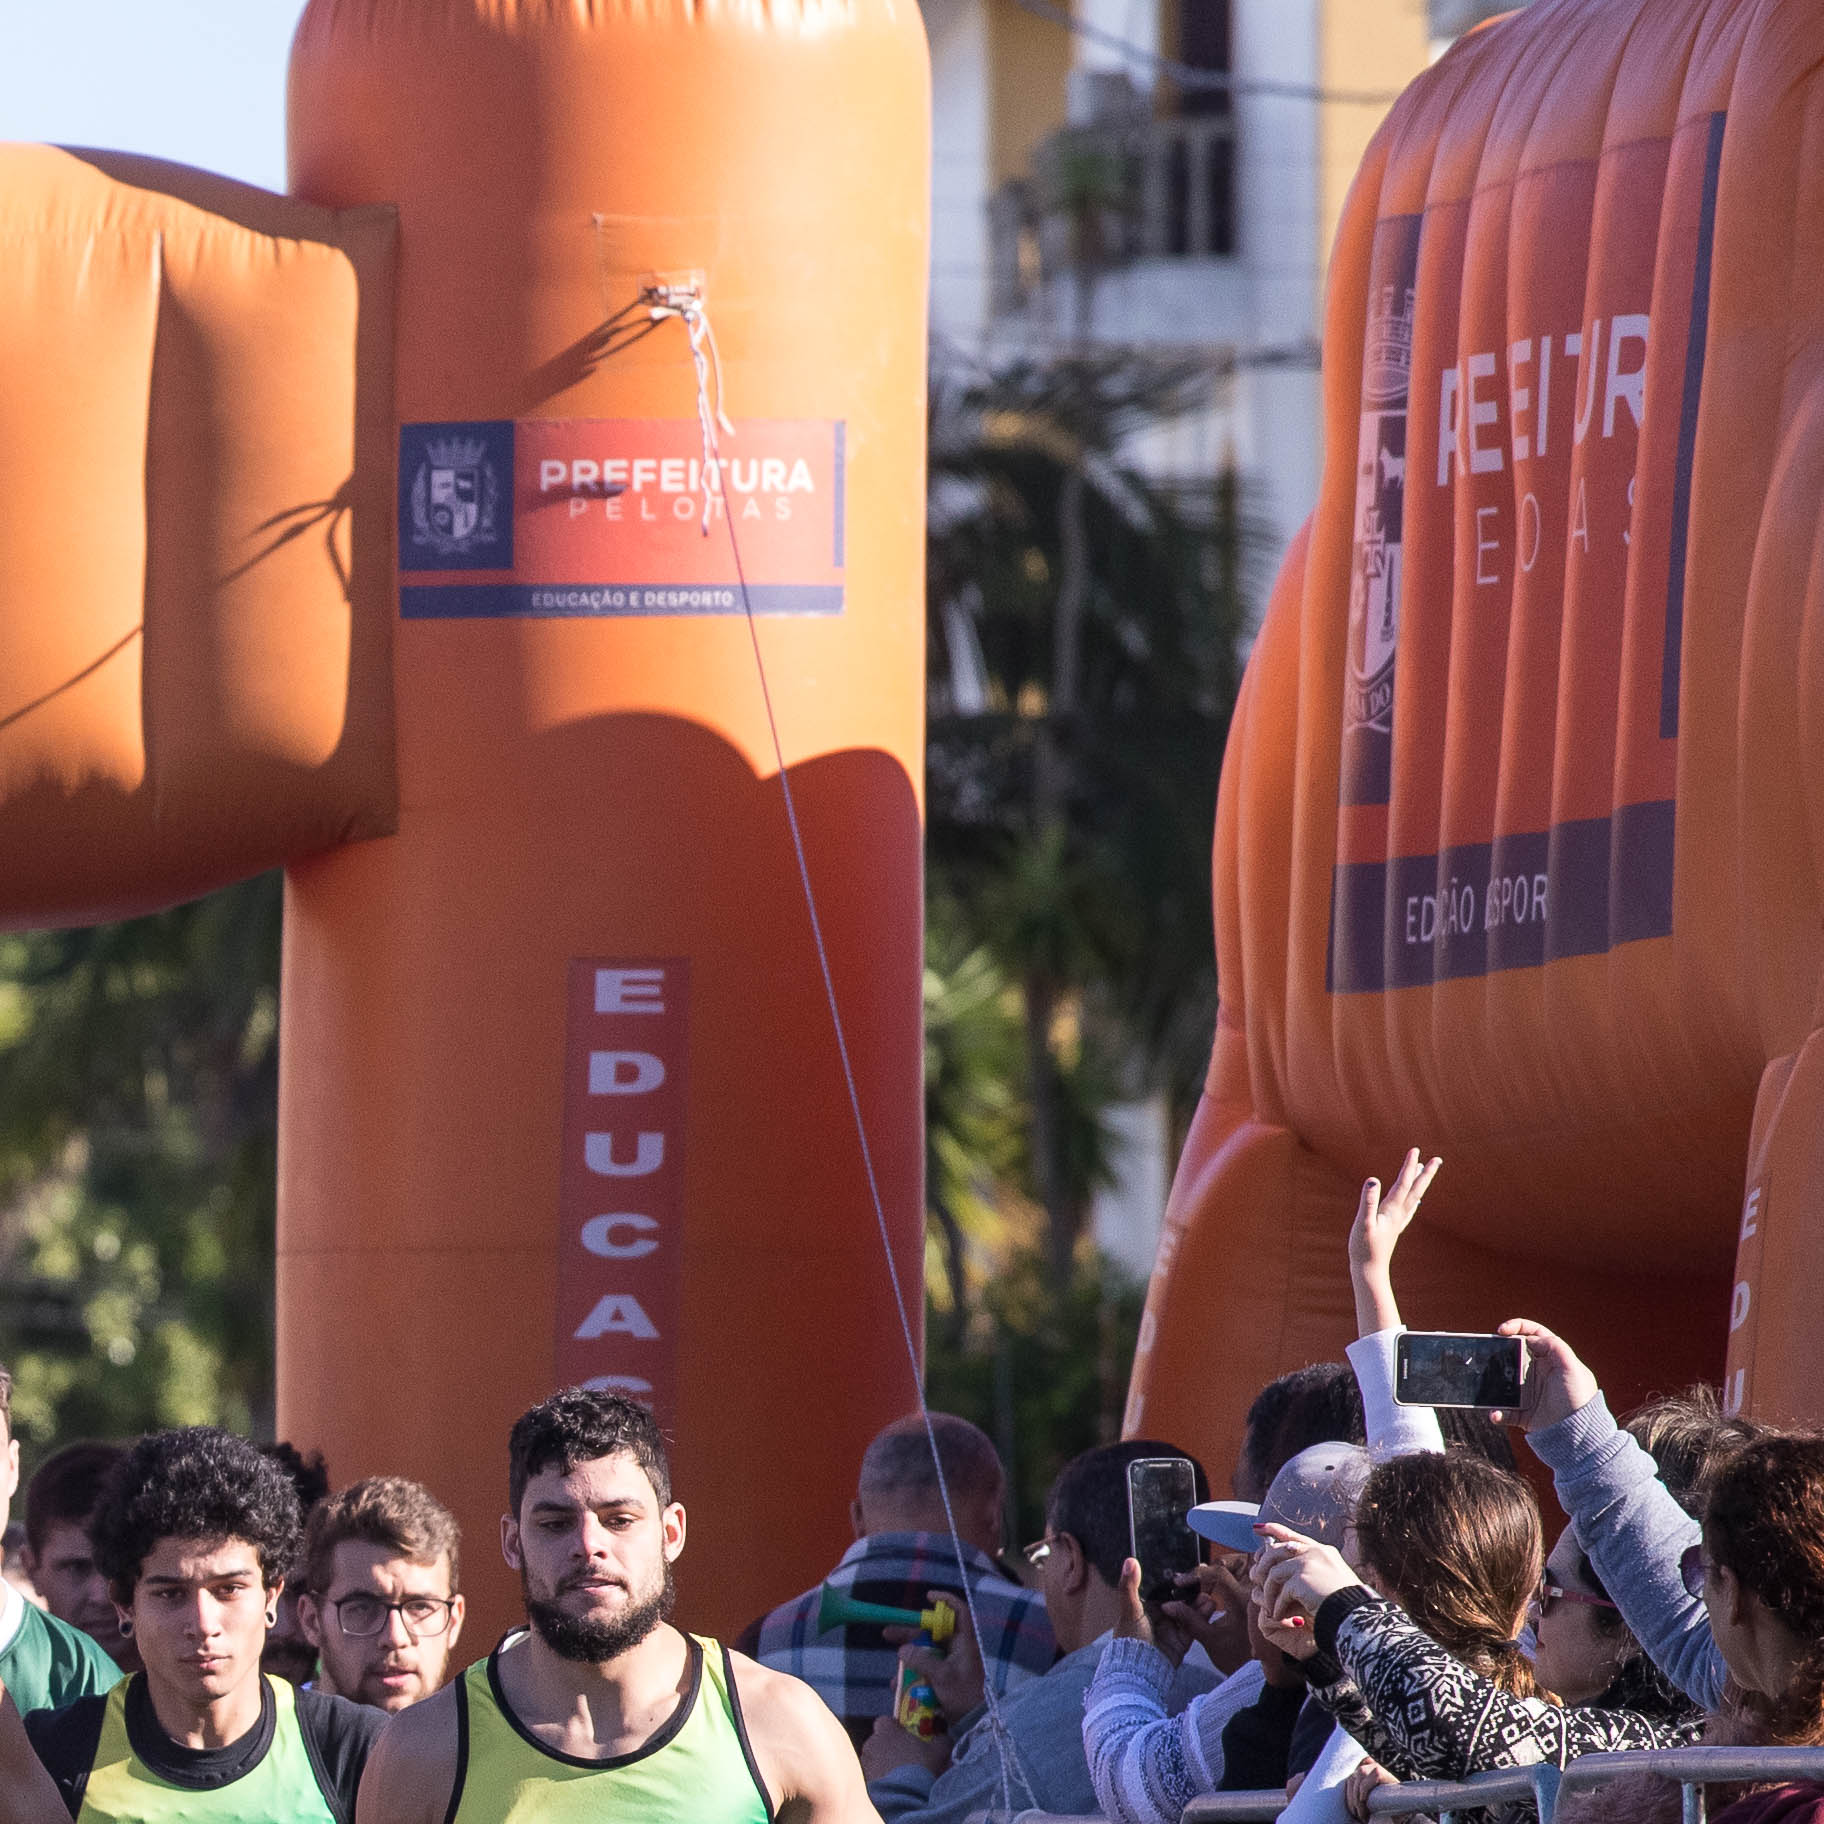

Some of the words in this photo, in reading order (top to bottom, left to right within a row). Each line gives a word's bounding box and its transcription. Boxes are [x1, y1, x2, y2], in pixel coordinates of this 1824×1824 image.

[539, 457, 816, 494] PREFEITURA
[568, 496, 793, 522] PELOTAS
[531, 590, 625, 609] EDUCAÇÃO
[628, 590, 641, 607] E
[644, 591, 735, 608] DESPORTO
